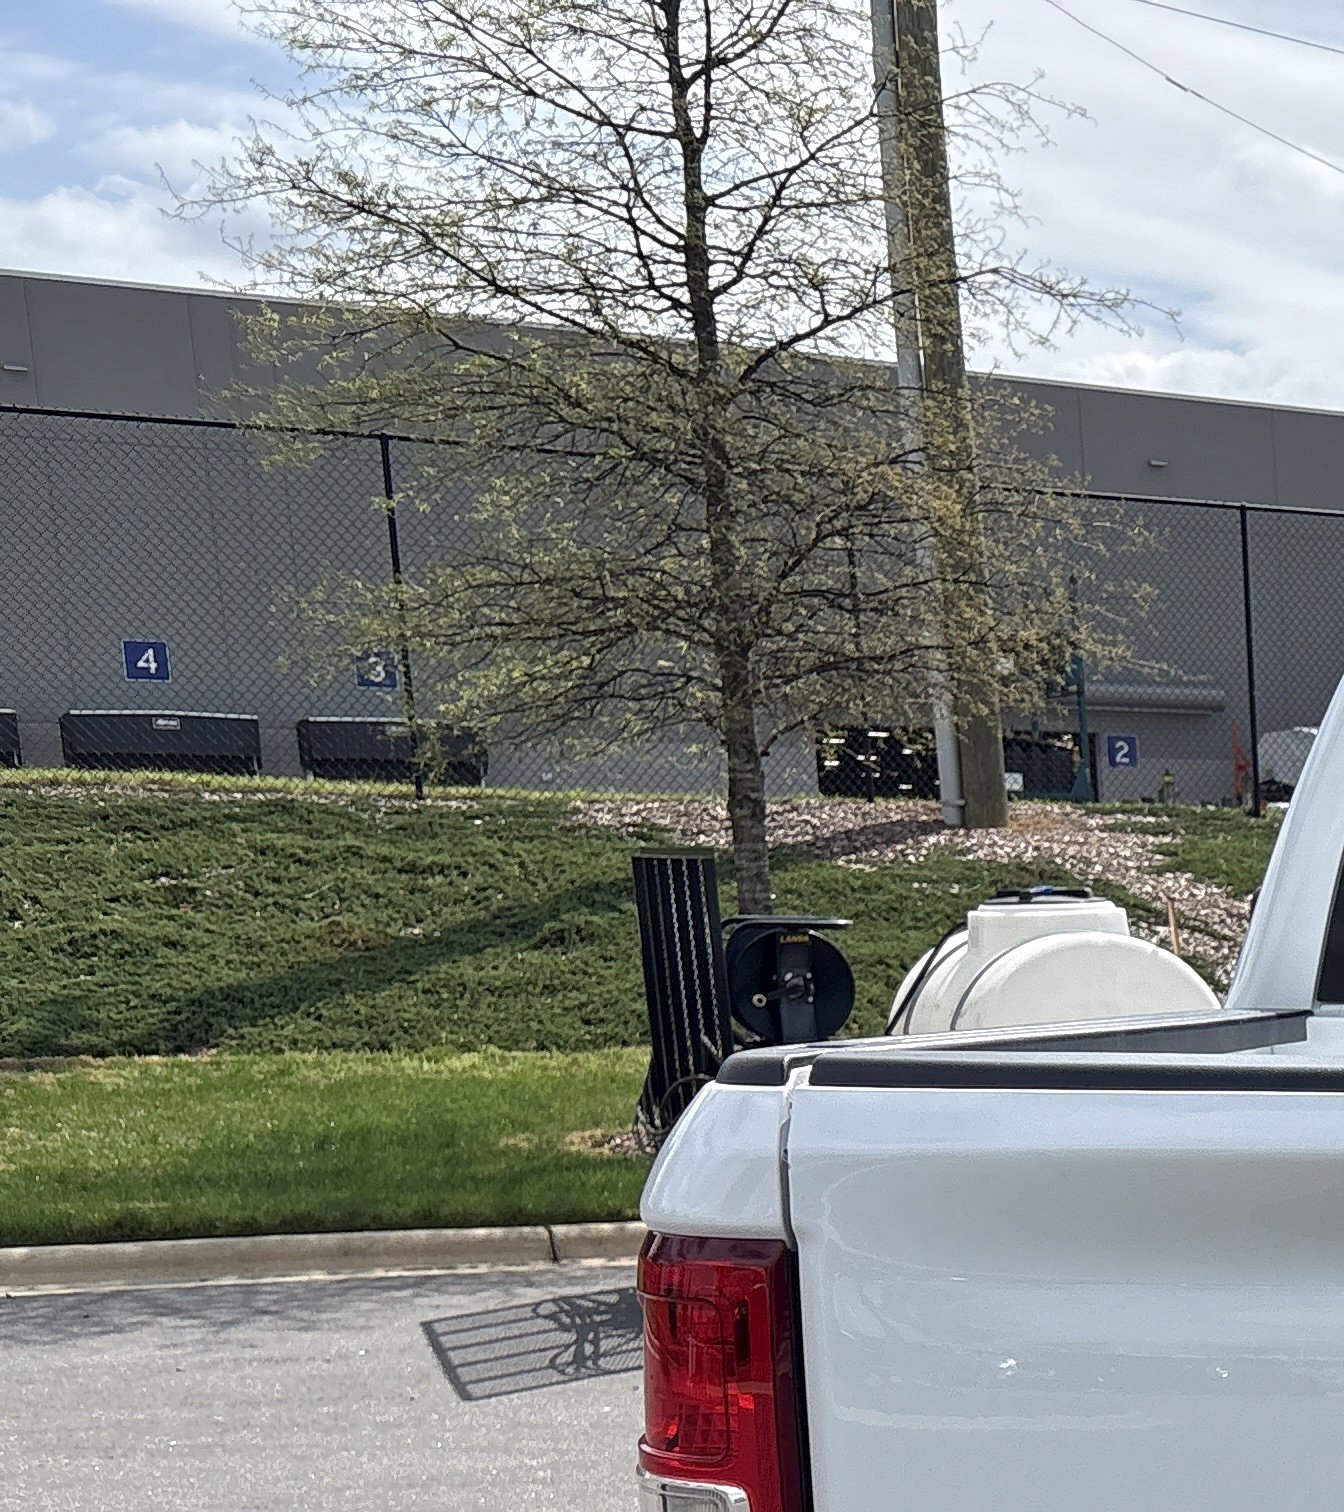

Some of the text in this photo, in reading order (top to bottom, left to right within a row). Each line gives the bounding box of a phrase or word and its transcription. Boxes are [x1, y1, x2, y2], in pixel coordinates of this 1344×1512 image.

[136, 648, 158, 674] 4
[367, 657, 386, 682] 3
[1114, 740, 1130, 763] 2
